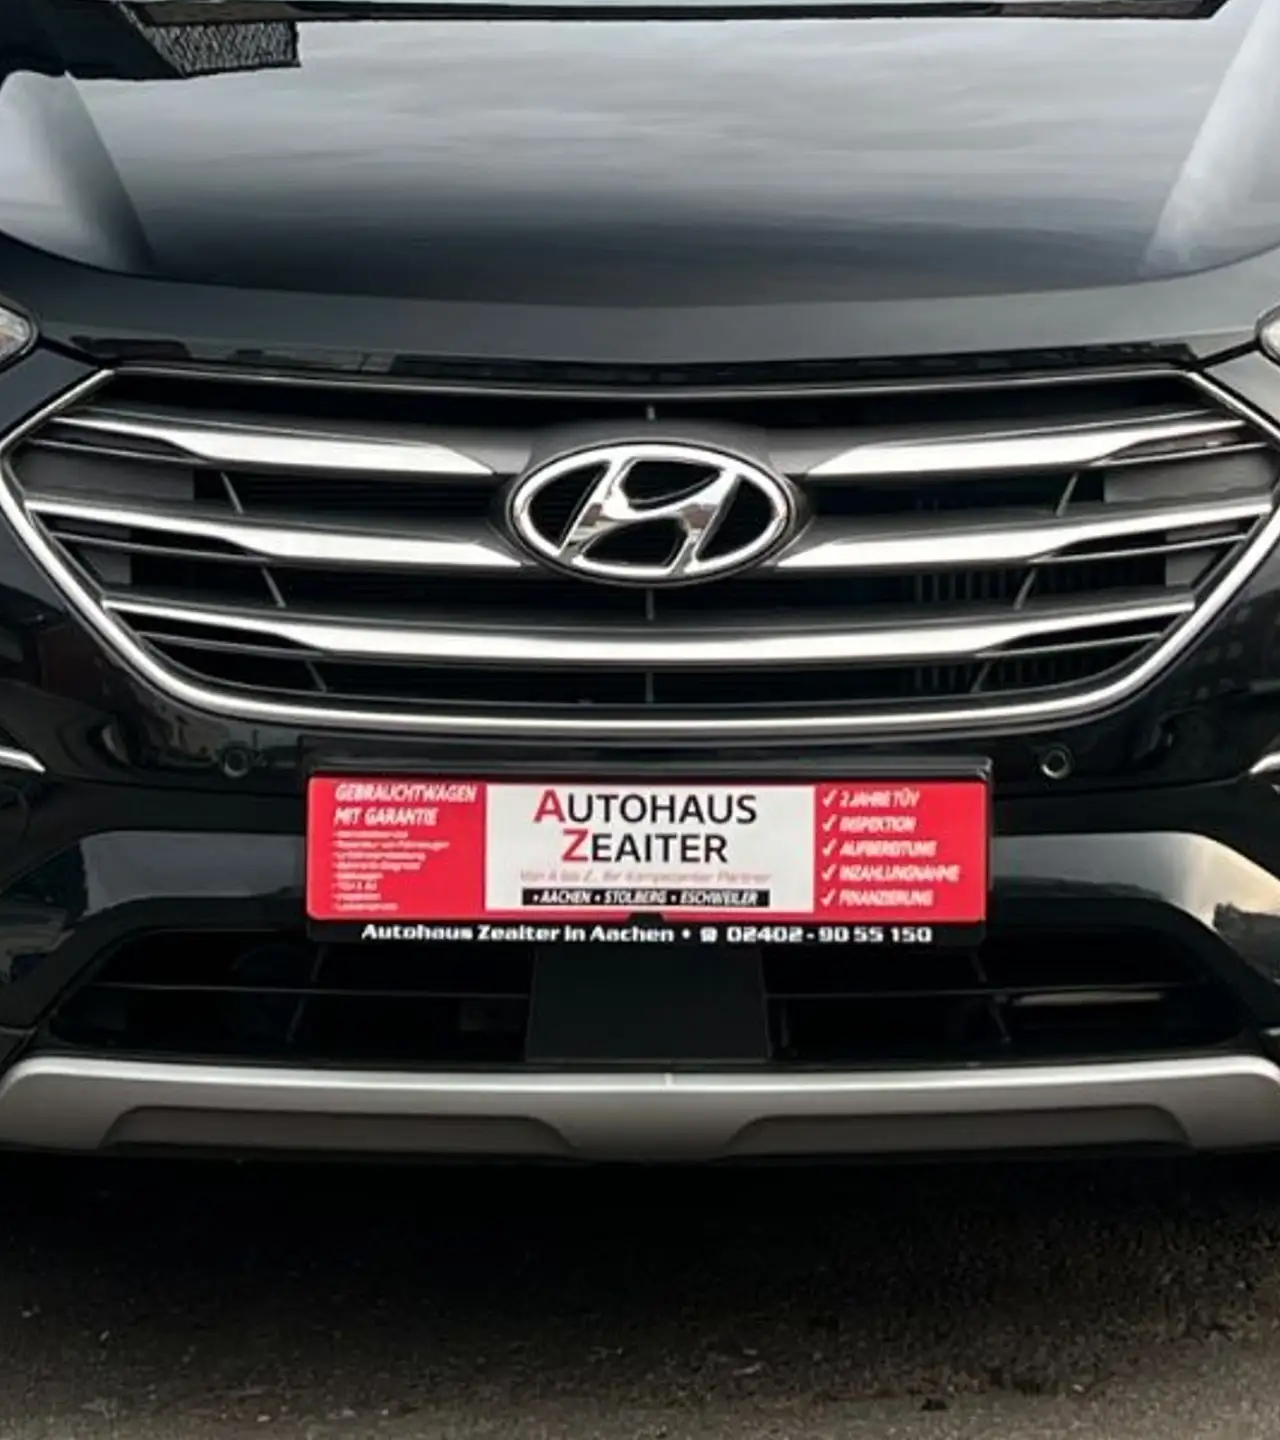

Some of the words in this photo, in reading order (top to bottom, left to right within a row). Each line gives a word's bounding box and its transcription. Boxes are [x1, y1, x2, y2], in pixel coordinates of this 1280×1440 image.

[335, 783, 478, 802] GEBRAUCHTWAGEN
[533, 788, 758, 825] AUTOHAUS
[334, 808, 361, 825] MIT
[365, 807, 439, 826] GARANTIE
[562, 828, 728, 863] ZEAITER
[540, 890, 591, 904] AACHEN
[604, 890, 668, 905] STOLBERG
[361, 924, 473, 941] Autohaus
[477, 924, 560, 941] Zeaiter
[590, 925, 675, 942] Aachen
[726, 926, 803, 942] 02402
[890, 926, 933, 942] 150
